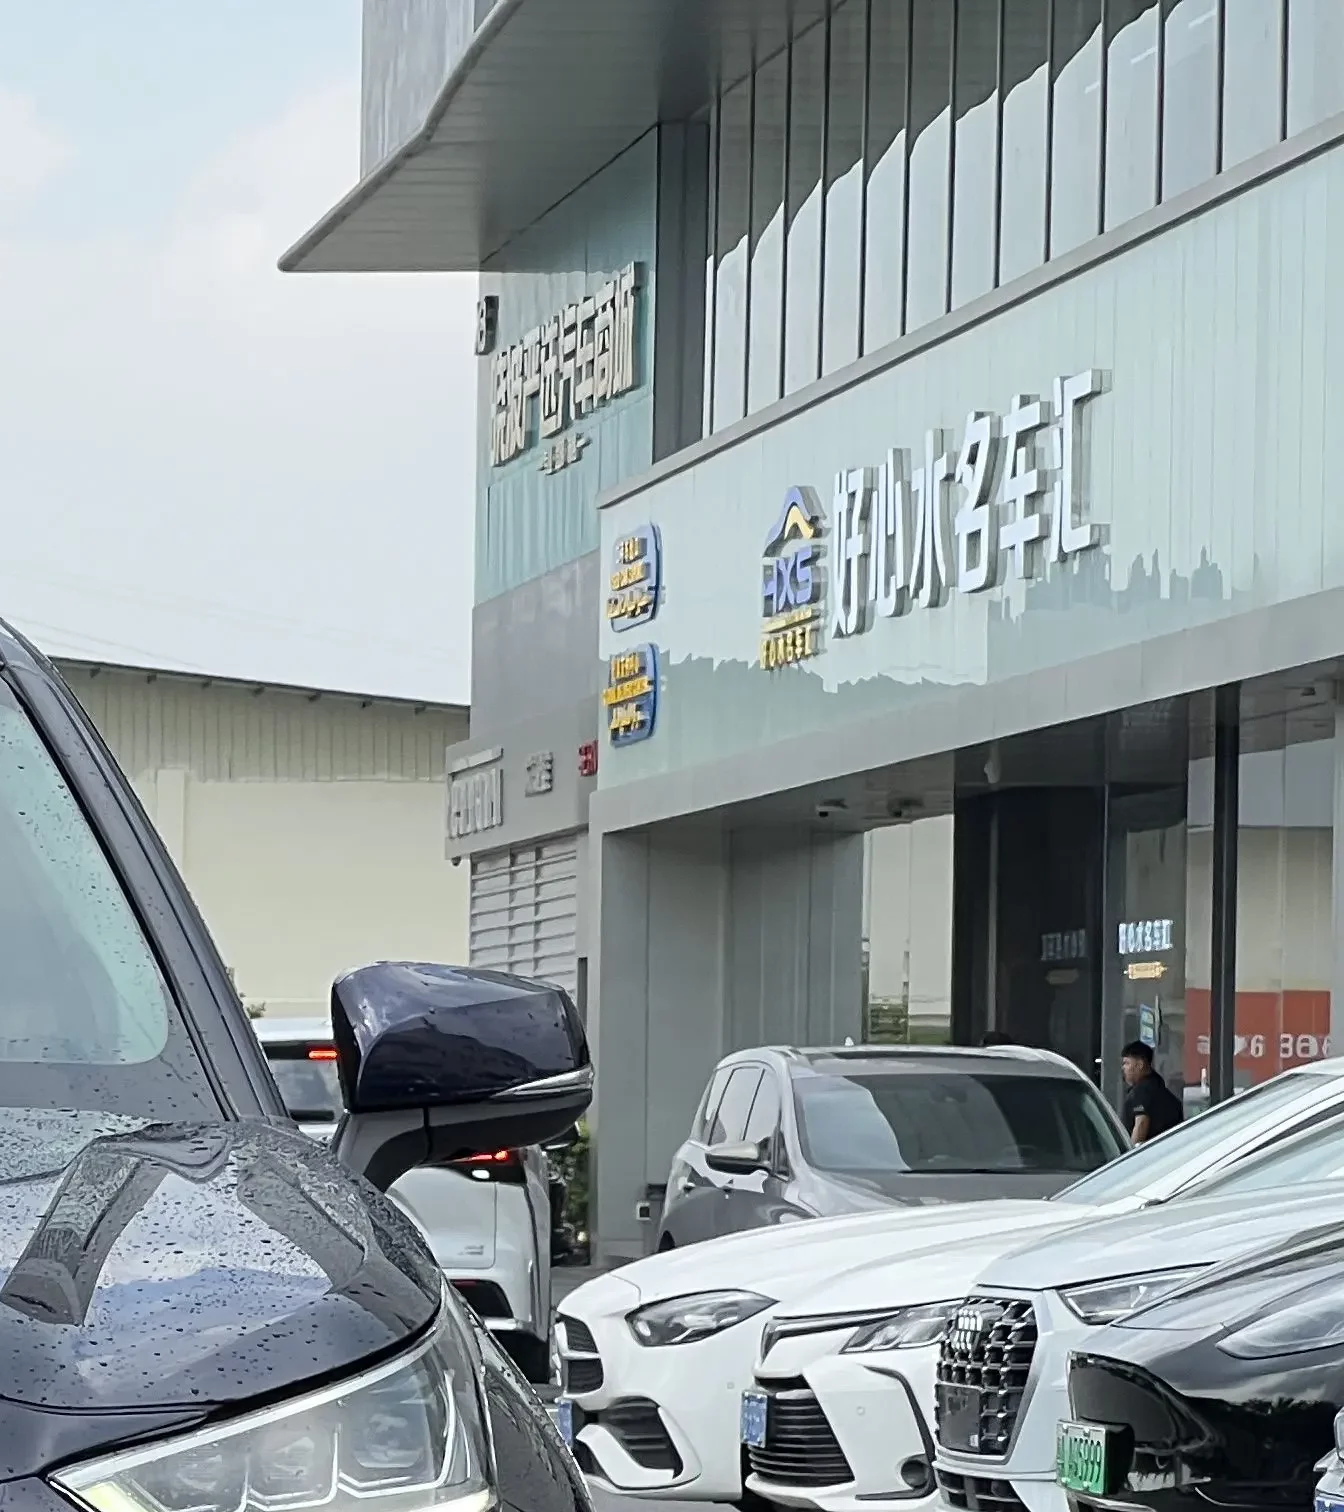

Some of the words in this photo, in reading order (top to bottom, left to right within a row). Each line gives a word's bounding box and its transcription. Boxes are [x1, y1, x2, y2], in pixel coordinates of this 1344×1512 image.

[831, 369, 1106, 640] 好心水名车汇
